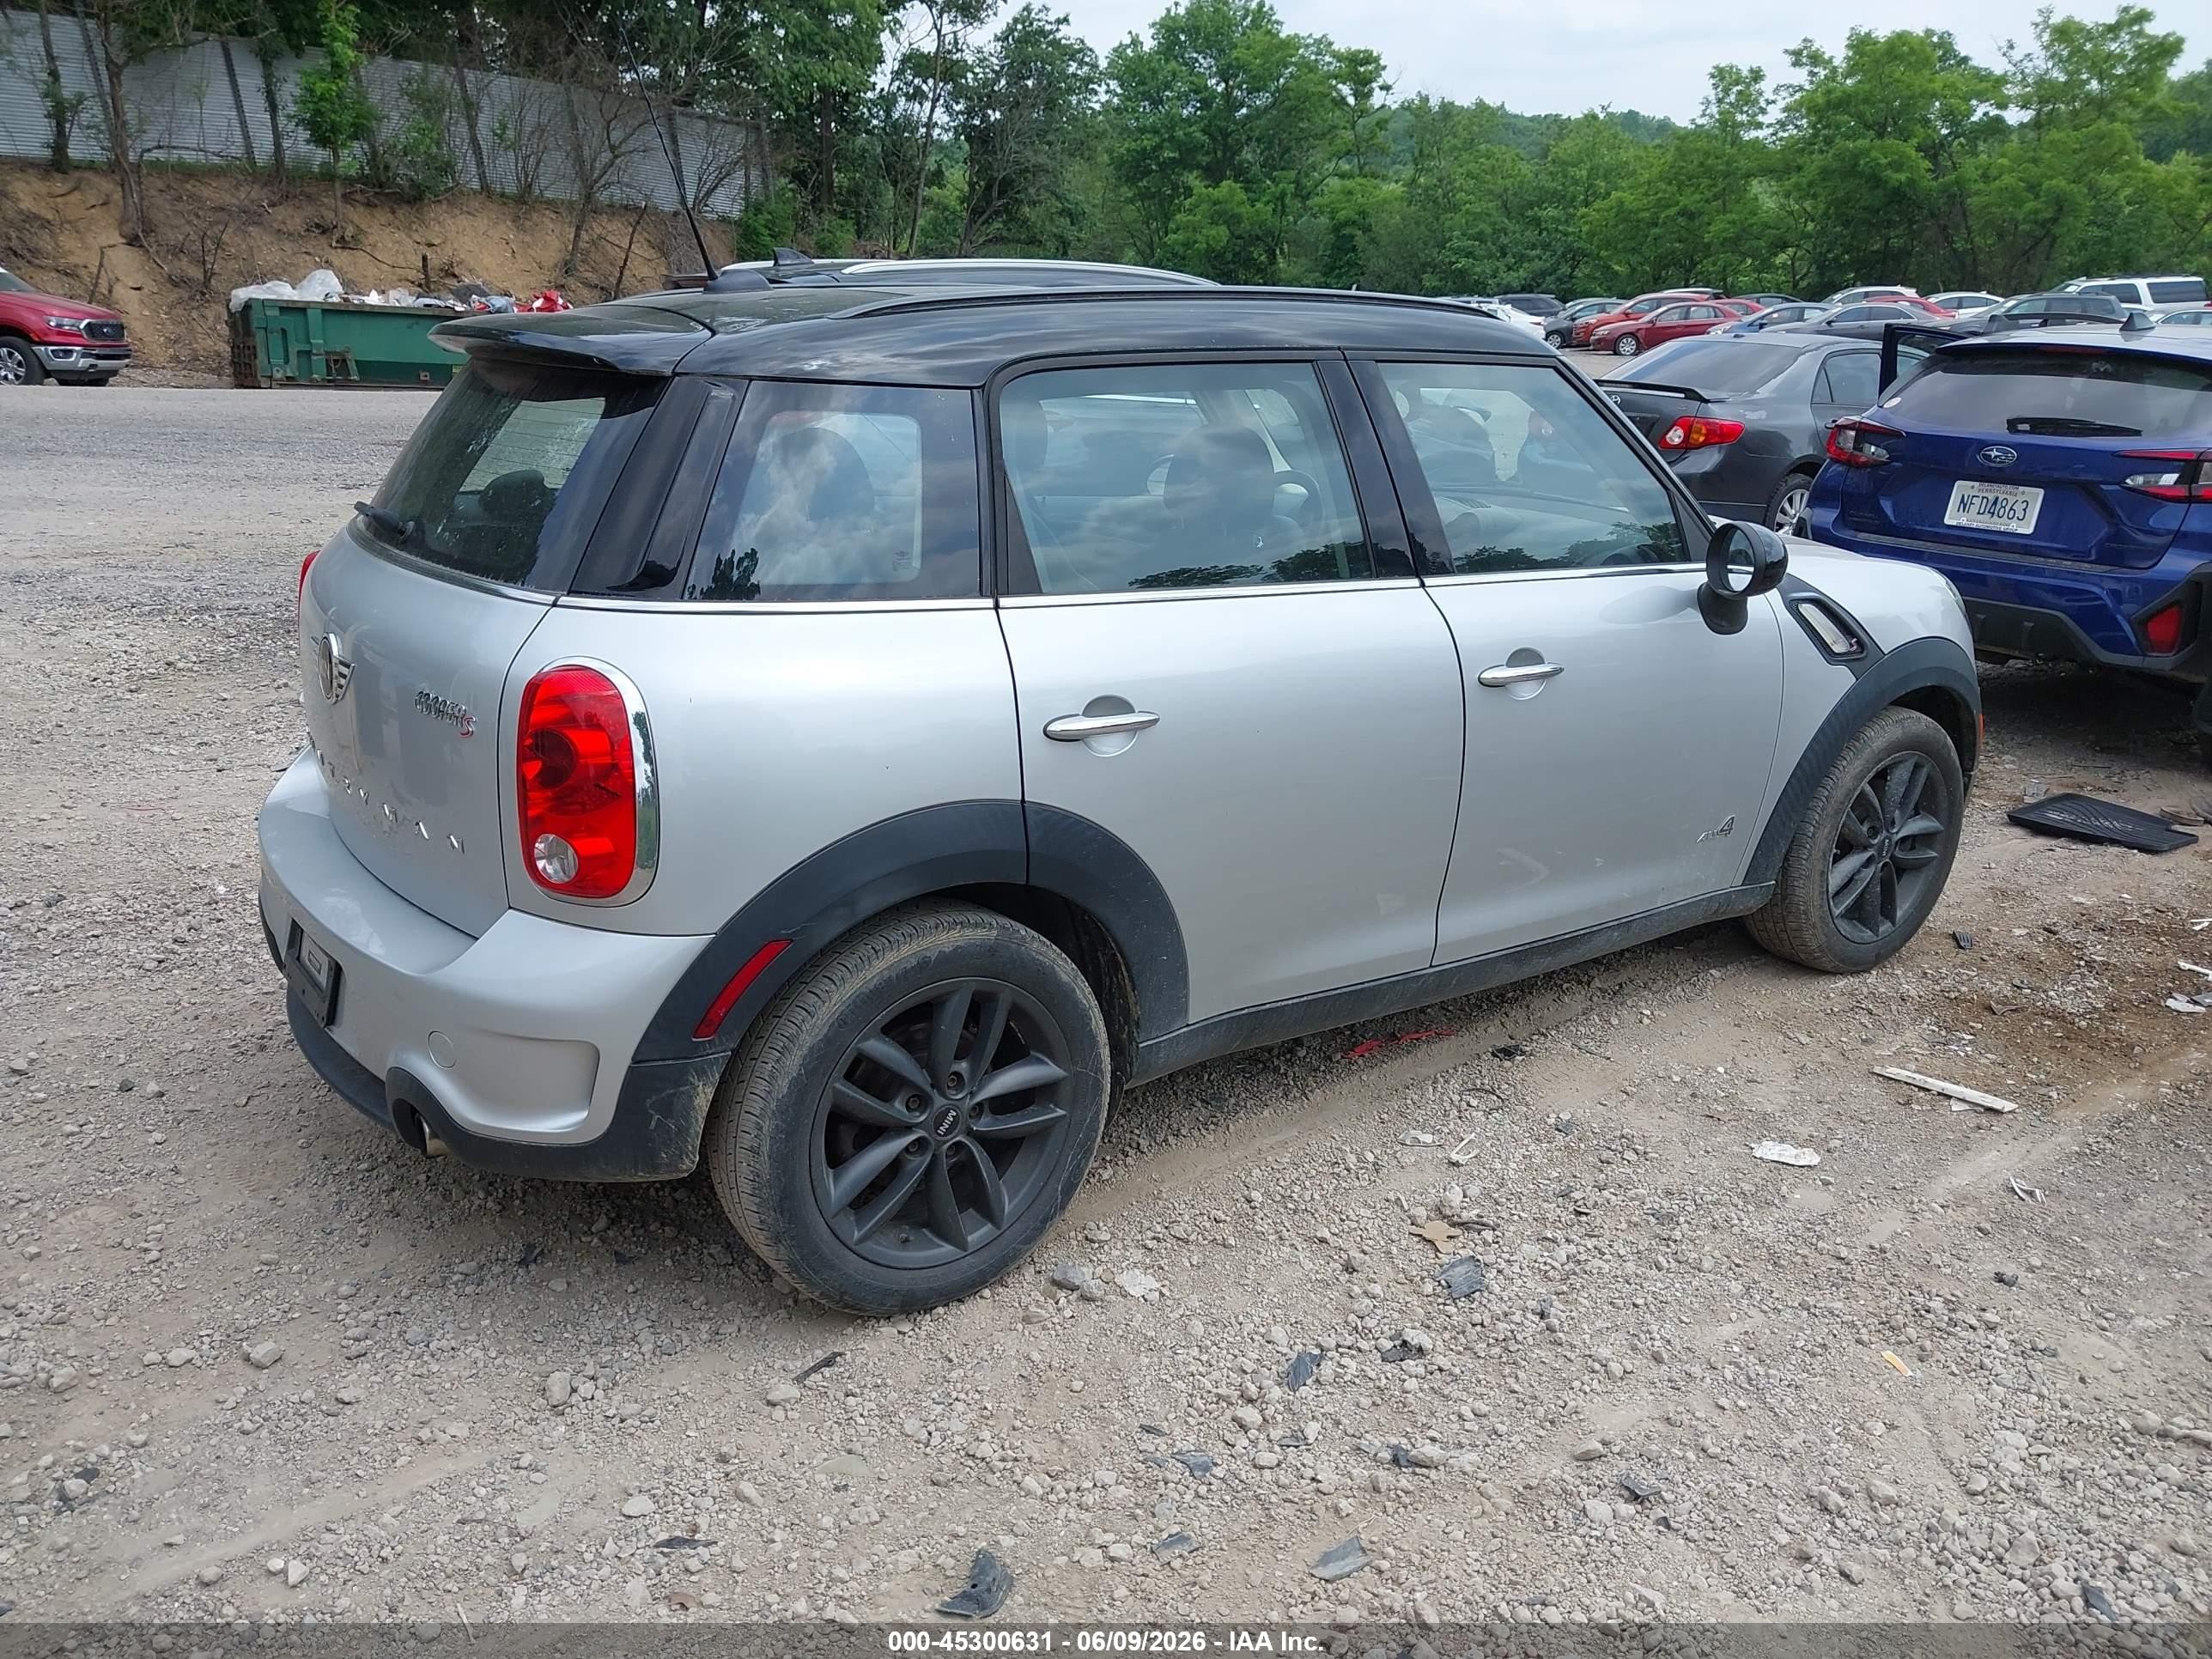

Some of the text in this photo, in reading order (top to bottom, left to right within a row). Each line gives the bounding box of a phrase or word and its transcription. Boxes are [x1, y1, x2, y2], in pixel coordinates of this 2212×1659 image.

[1978, 488, 2018, 497] PENNSYLVANIA
[1956, 493, 2030, 521] NFD4863
[937, 1109, 957, 1135] MINI
